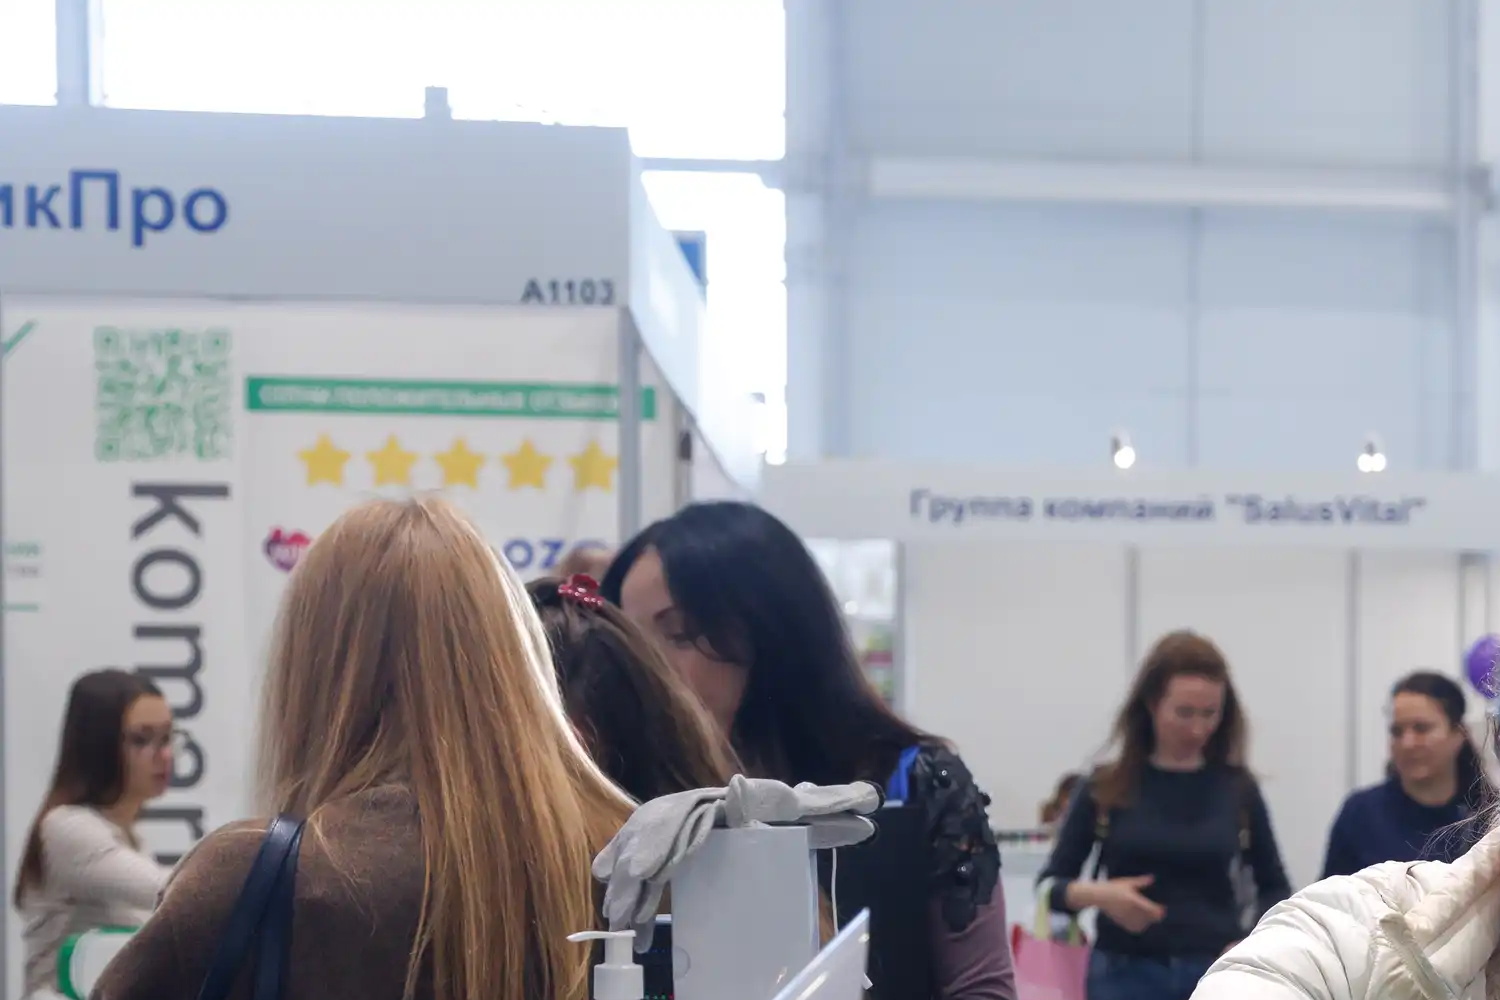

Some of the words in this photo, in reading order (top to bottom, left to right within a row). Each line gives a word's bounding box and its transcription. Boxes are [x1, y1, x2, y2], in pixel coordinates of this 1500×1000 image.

[519, 277, 616, 304] A1103
[909, 488, 1034, 525] Группа
[1043, 492, 1215, 521] компаний
